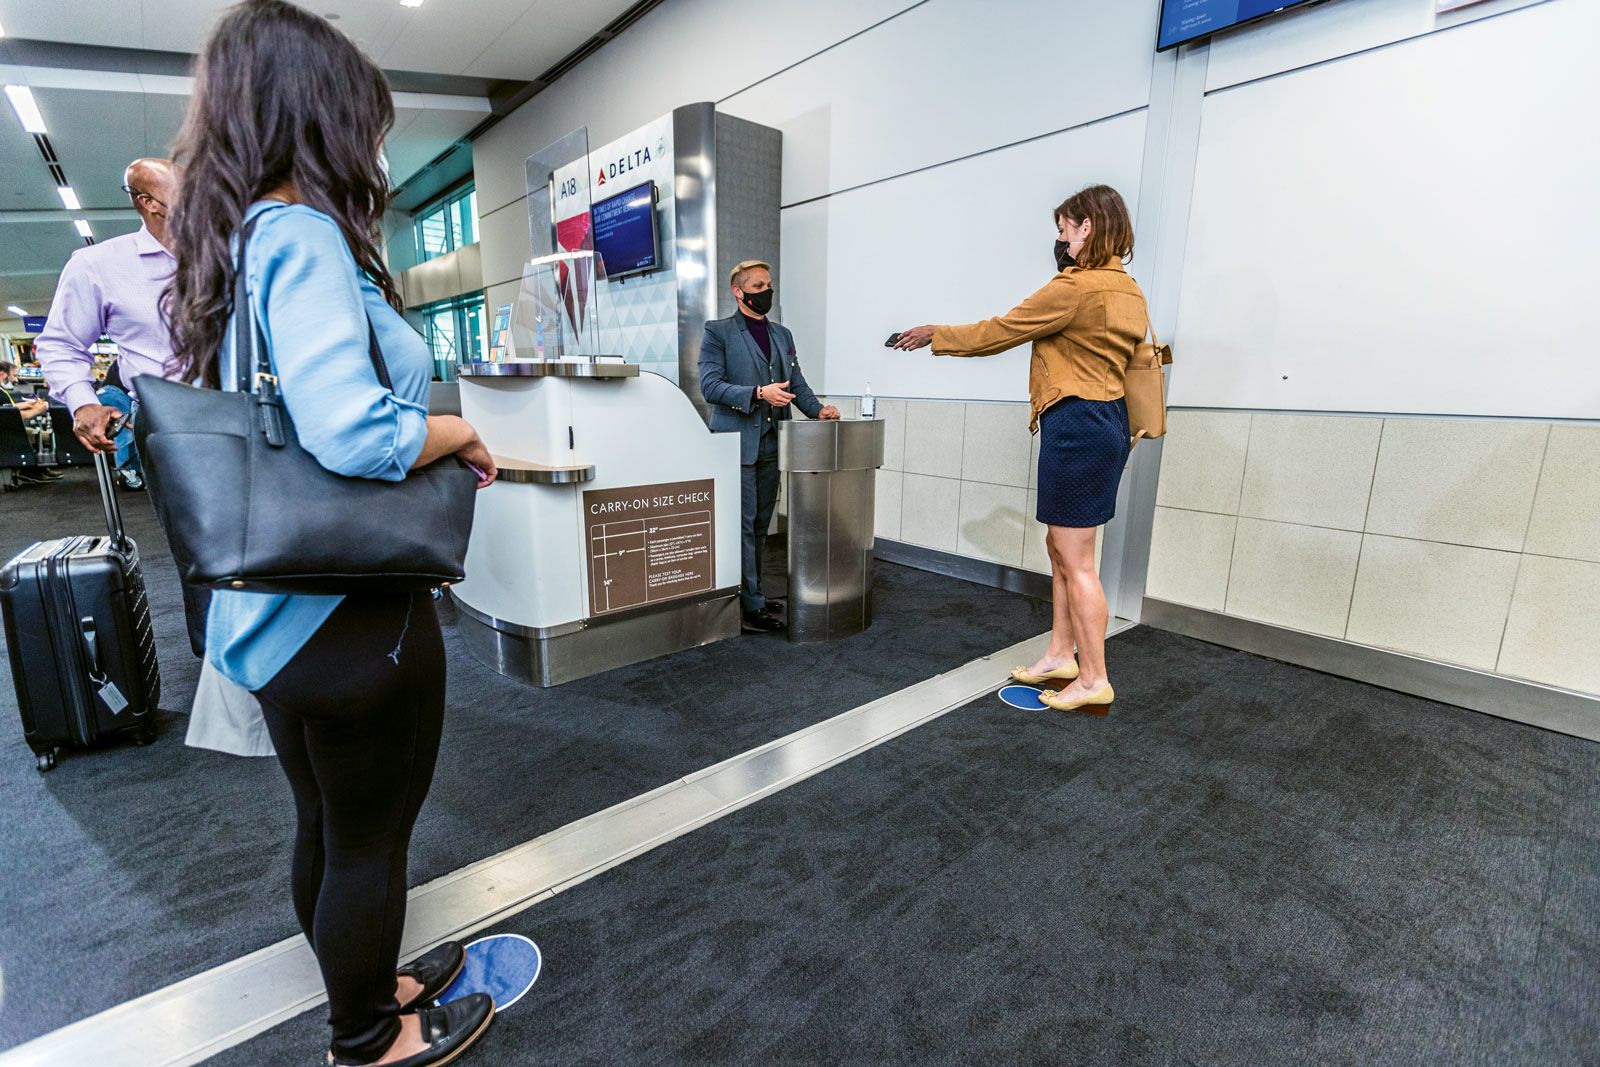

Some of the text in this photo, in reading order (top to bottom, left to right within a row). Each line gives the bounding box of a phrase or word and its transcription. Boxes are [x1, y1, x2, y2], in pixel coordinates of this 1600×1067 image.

[610, 146, 651, 178] DELTA
[561, 178, 576, 199] A18
[590, 492, 710, 514] CARRY-ON SIZE CHECK
